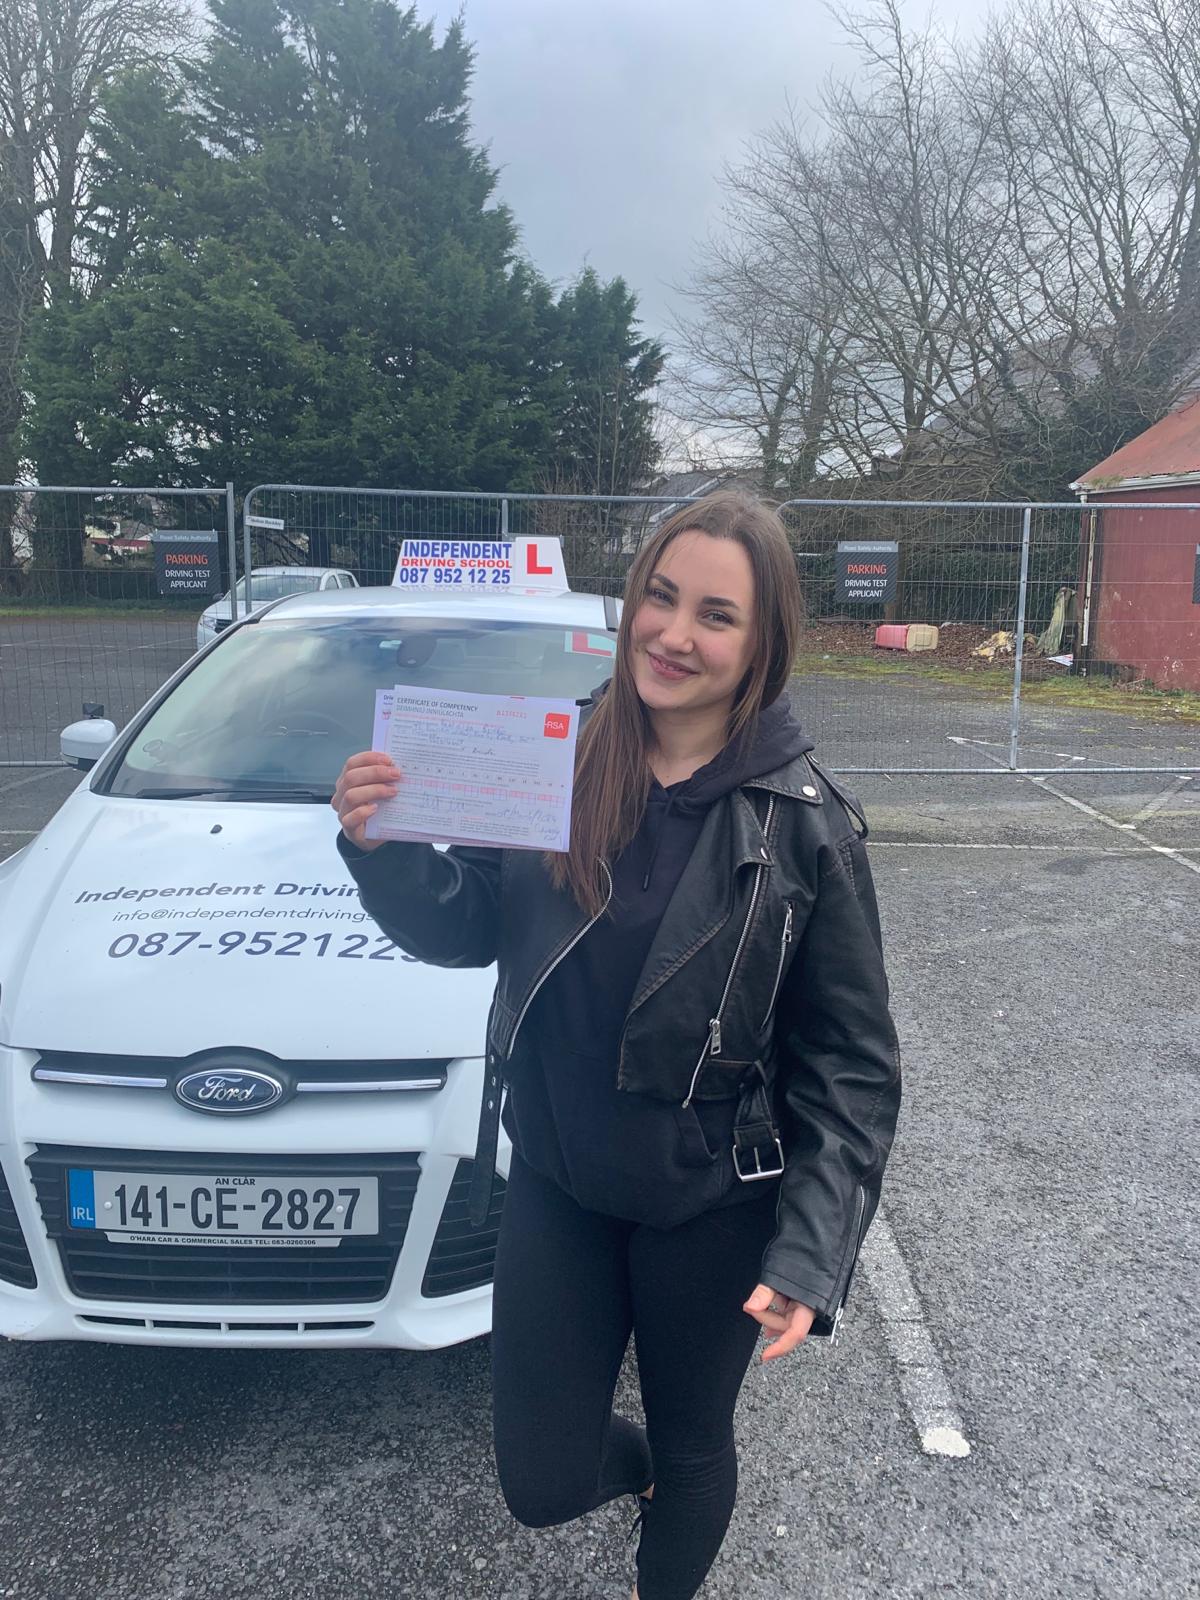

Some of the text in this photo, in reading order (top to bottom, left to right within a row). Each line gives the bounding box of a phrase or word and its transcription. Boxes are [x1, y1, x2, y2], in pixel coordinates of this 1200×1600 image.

[404, 541, 513, 559] INDEPENDENT
[166, 553, 209, 565] PARKING
[401, 558, 513, 569] DRIVING SCHOOL
[527, 544, 553, 575] L
[165, 569, 211, 578] DRIVING TEST
[400, 567, 511, 584] 087 952 12 25
[847, 564, 888, 575] PARKING
[170, 580, 208, 588] APPLICANT
[844, 579, 888, 588] DRIVING TEST
[848, 589, 883, 598] APPLICANT
[572, 631, 613, 657] L
[397, 697, 430, 707] CERTIFICATE
[440, 702, 479, 712] COMPETENCY
[546, 720, 565, 731] RSA
[75, 883, 267, 903] Independent
[198, 1076, 257, 1102] Ford
[215, 1177, 230, 1185] AN
[114, 1184, 361, 1230] 141-CE-2827
[72, 1206, 94, 1221] IRL
[129, 1235, 156, 1243] O'HARA
[181, 1237, 228, 1245] COMMERCIAL
